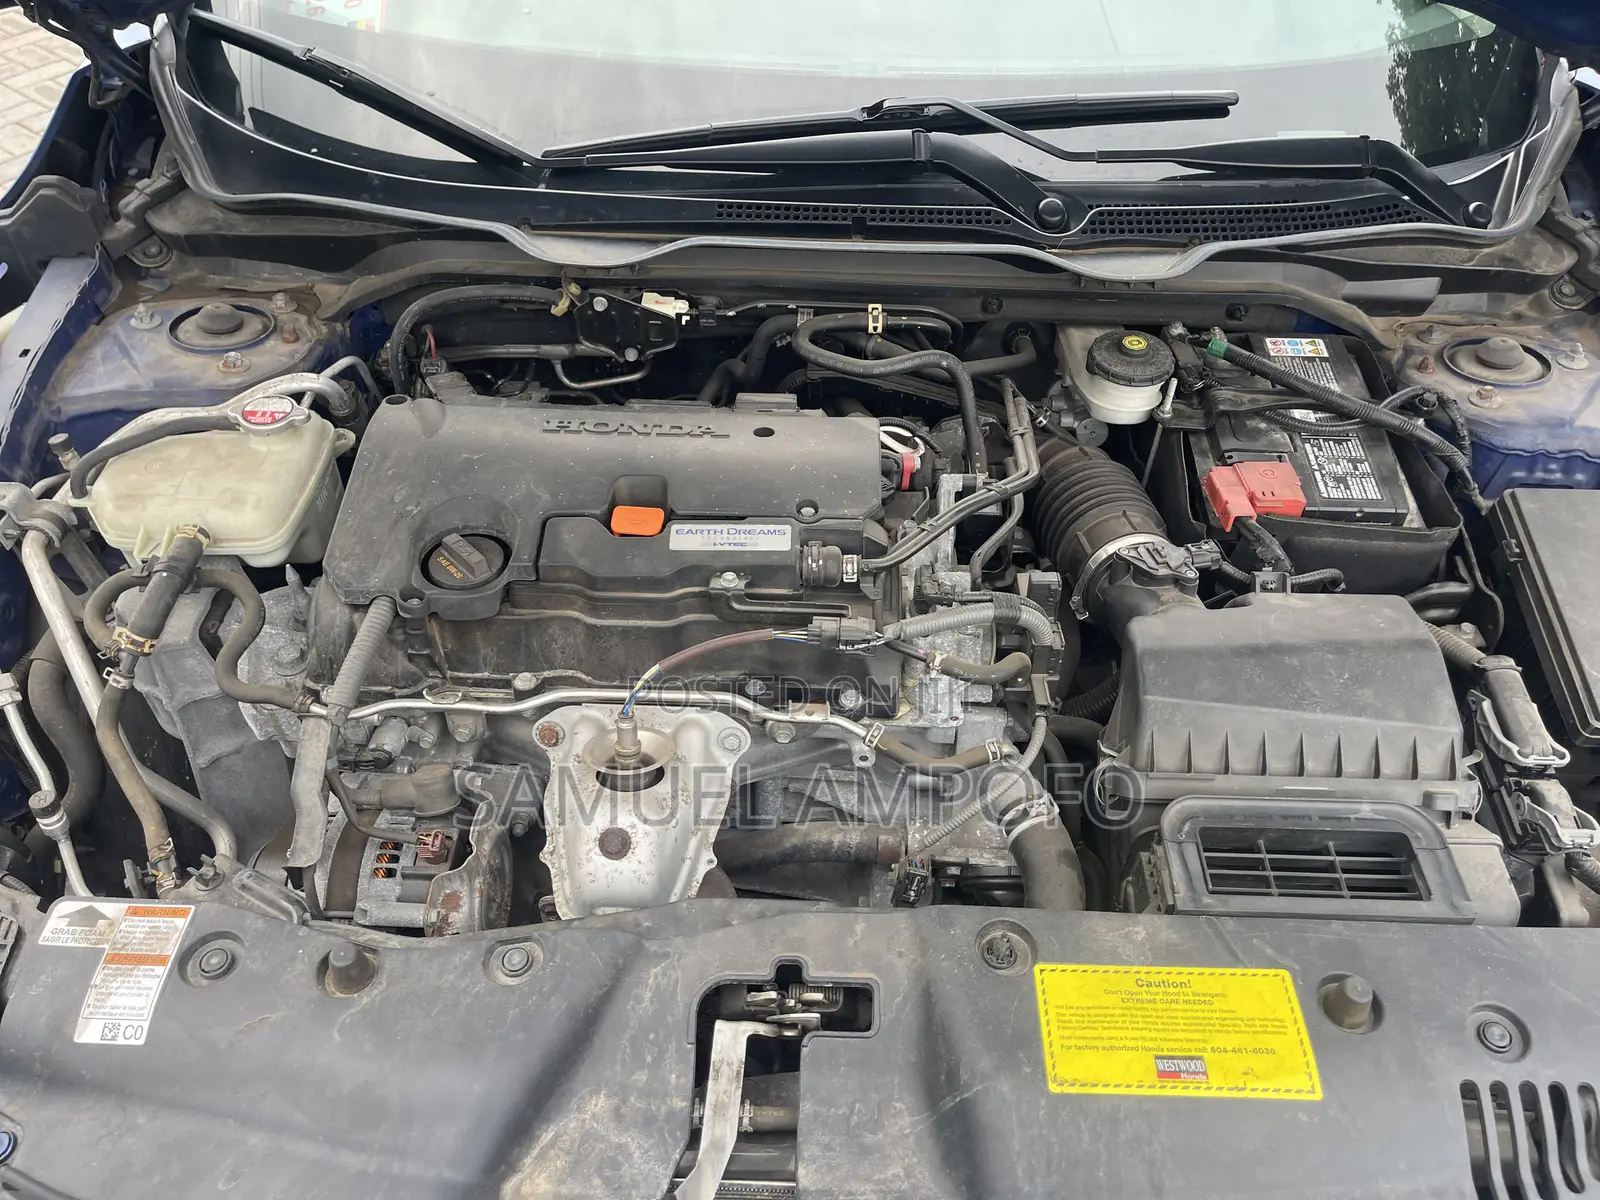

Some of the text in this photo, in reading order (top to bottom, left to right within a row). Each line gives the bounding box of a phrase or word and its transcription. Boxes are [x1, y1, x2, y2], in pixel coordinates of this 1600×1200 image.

[543, 420, 730, 438] HONDA
[727, 527, 786, 535] DREAMS
[437, 556, 464, 579] SAE 0W-20
[143, 908, 186, 916] WARNING
[51, 927, 106, 937] GRAB FOAM
[61, 936, 70, 944] LE
[1135, 978, 1192, 990] Caution!
[1156, 1059, 1206, 1072] WESTWOOD
[1180, 1072, 1208, 1080] Honda
